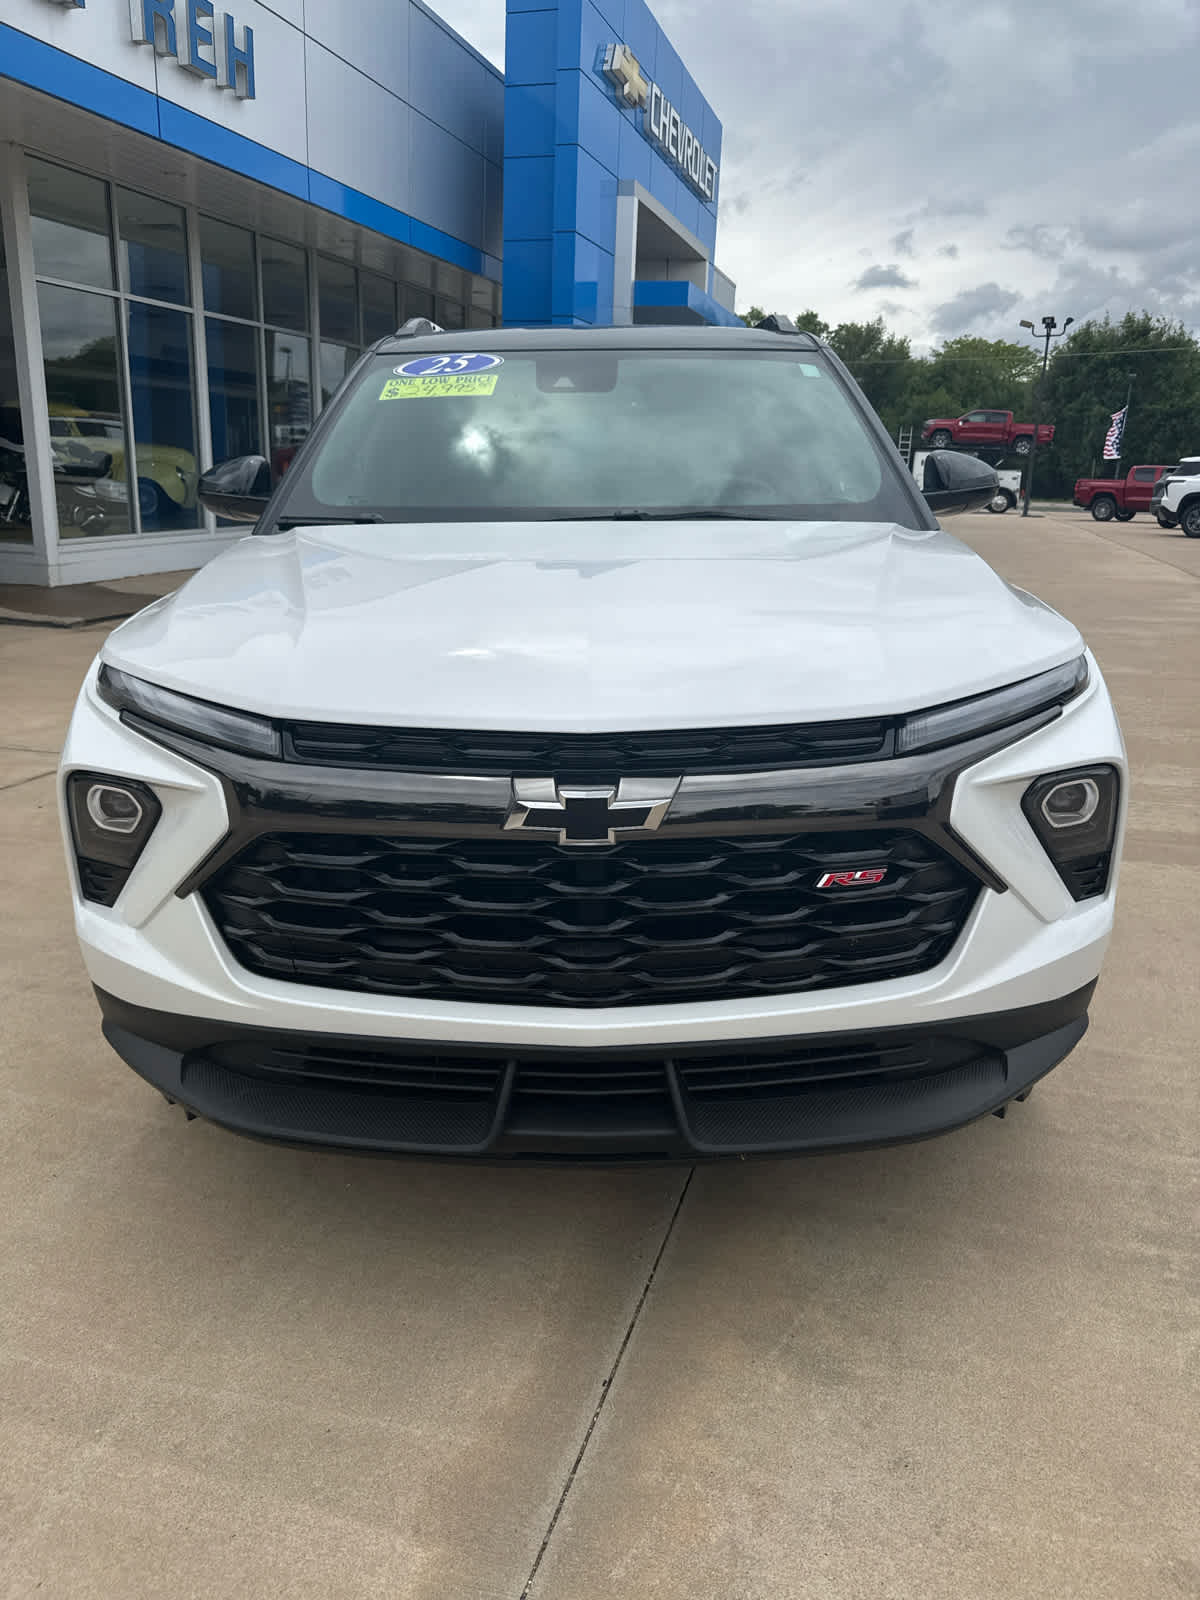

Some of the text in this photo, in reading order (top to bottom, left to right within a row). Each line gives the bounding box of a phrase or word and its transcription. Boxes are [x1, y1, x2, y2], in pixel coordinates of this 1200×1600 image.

[649, 80, 718, 203] CHEVROLET
[419, 354, 477, 375] 25
[389, 374, 494, 387] ONE LOW PRICE
[816, 868, 888, 888] RS
